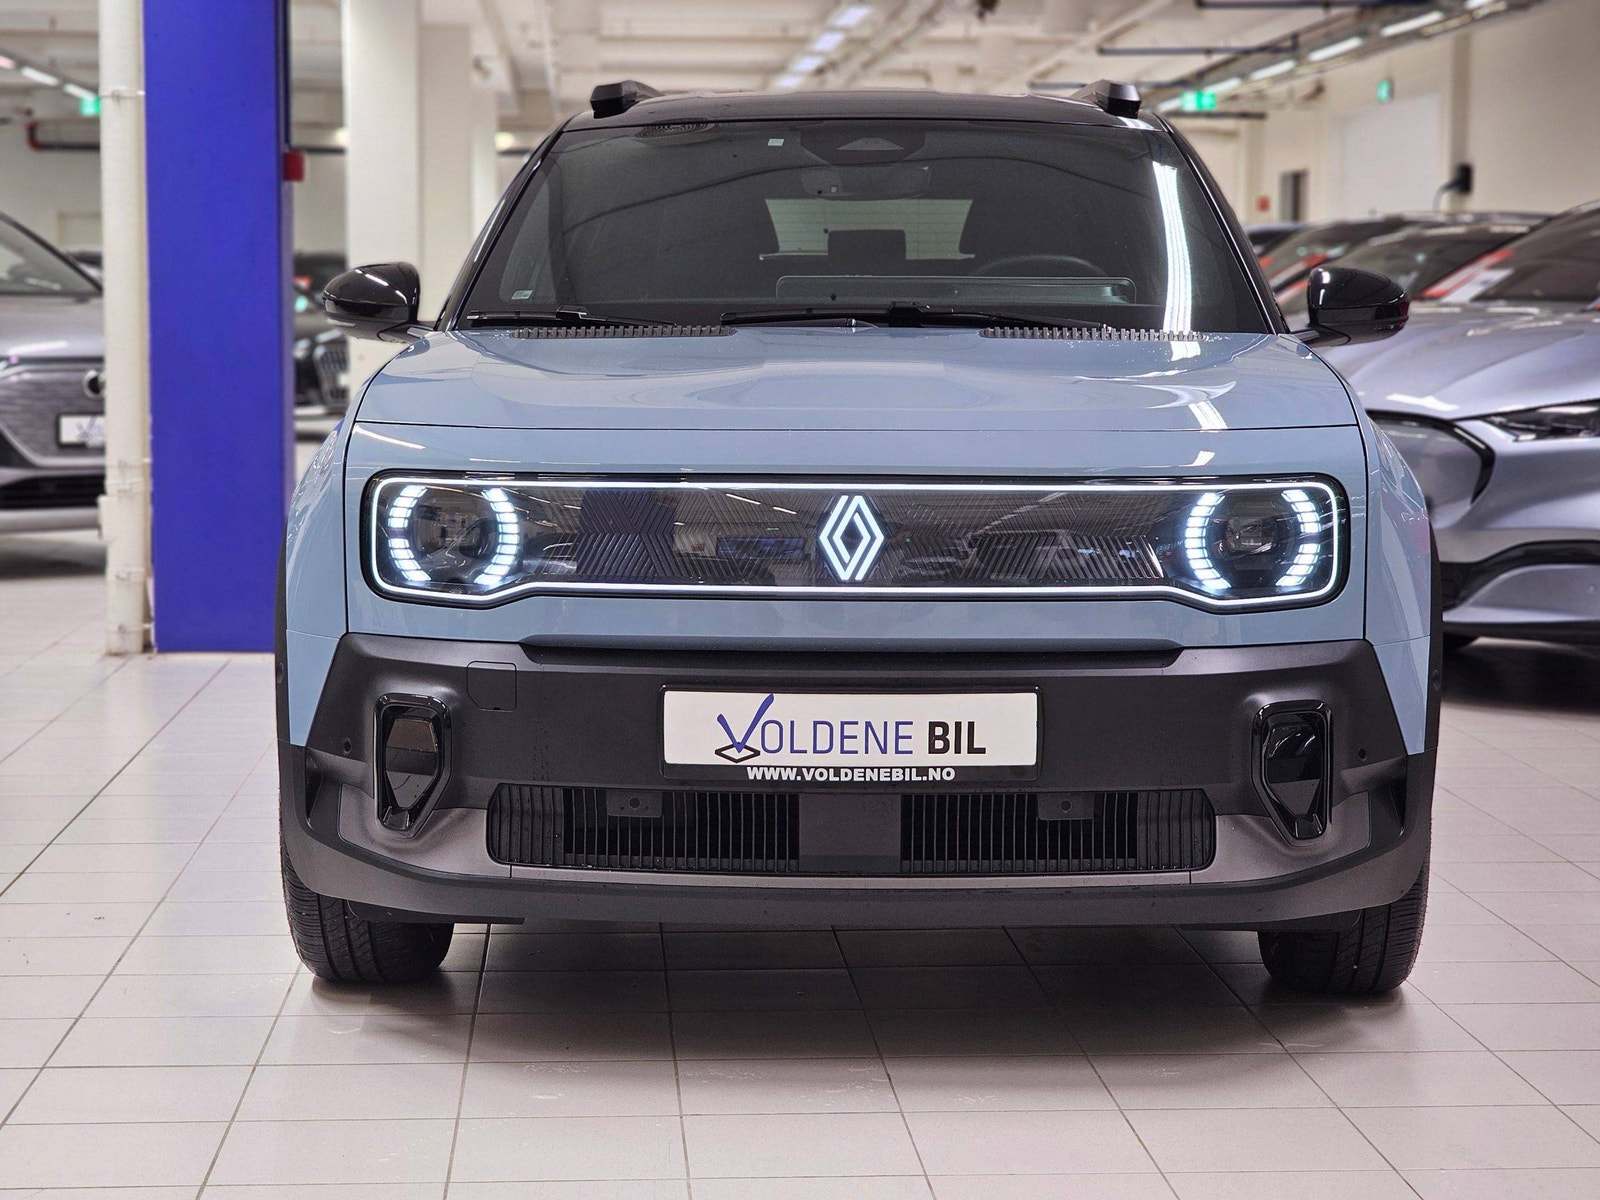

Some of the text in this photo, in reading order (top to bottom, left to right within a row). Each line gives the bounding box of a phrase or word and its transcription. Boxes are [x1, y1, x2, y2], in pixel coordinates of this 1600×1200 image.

[716, 693, 987, 756] VOLDENE BIL
[747, 766, 956, 782] WWW.VOLDENEBIL.NO
